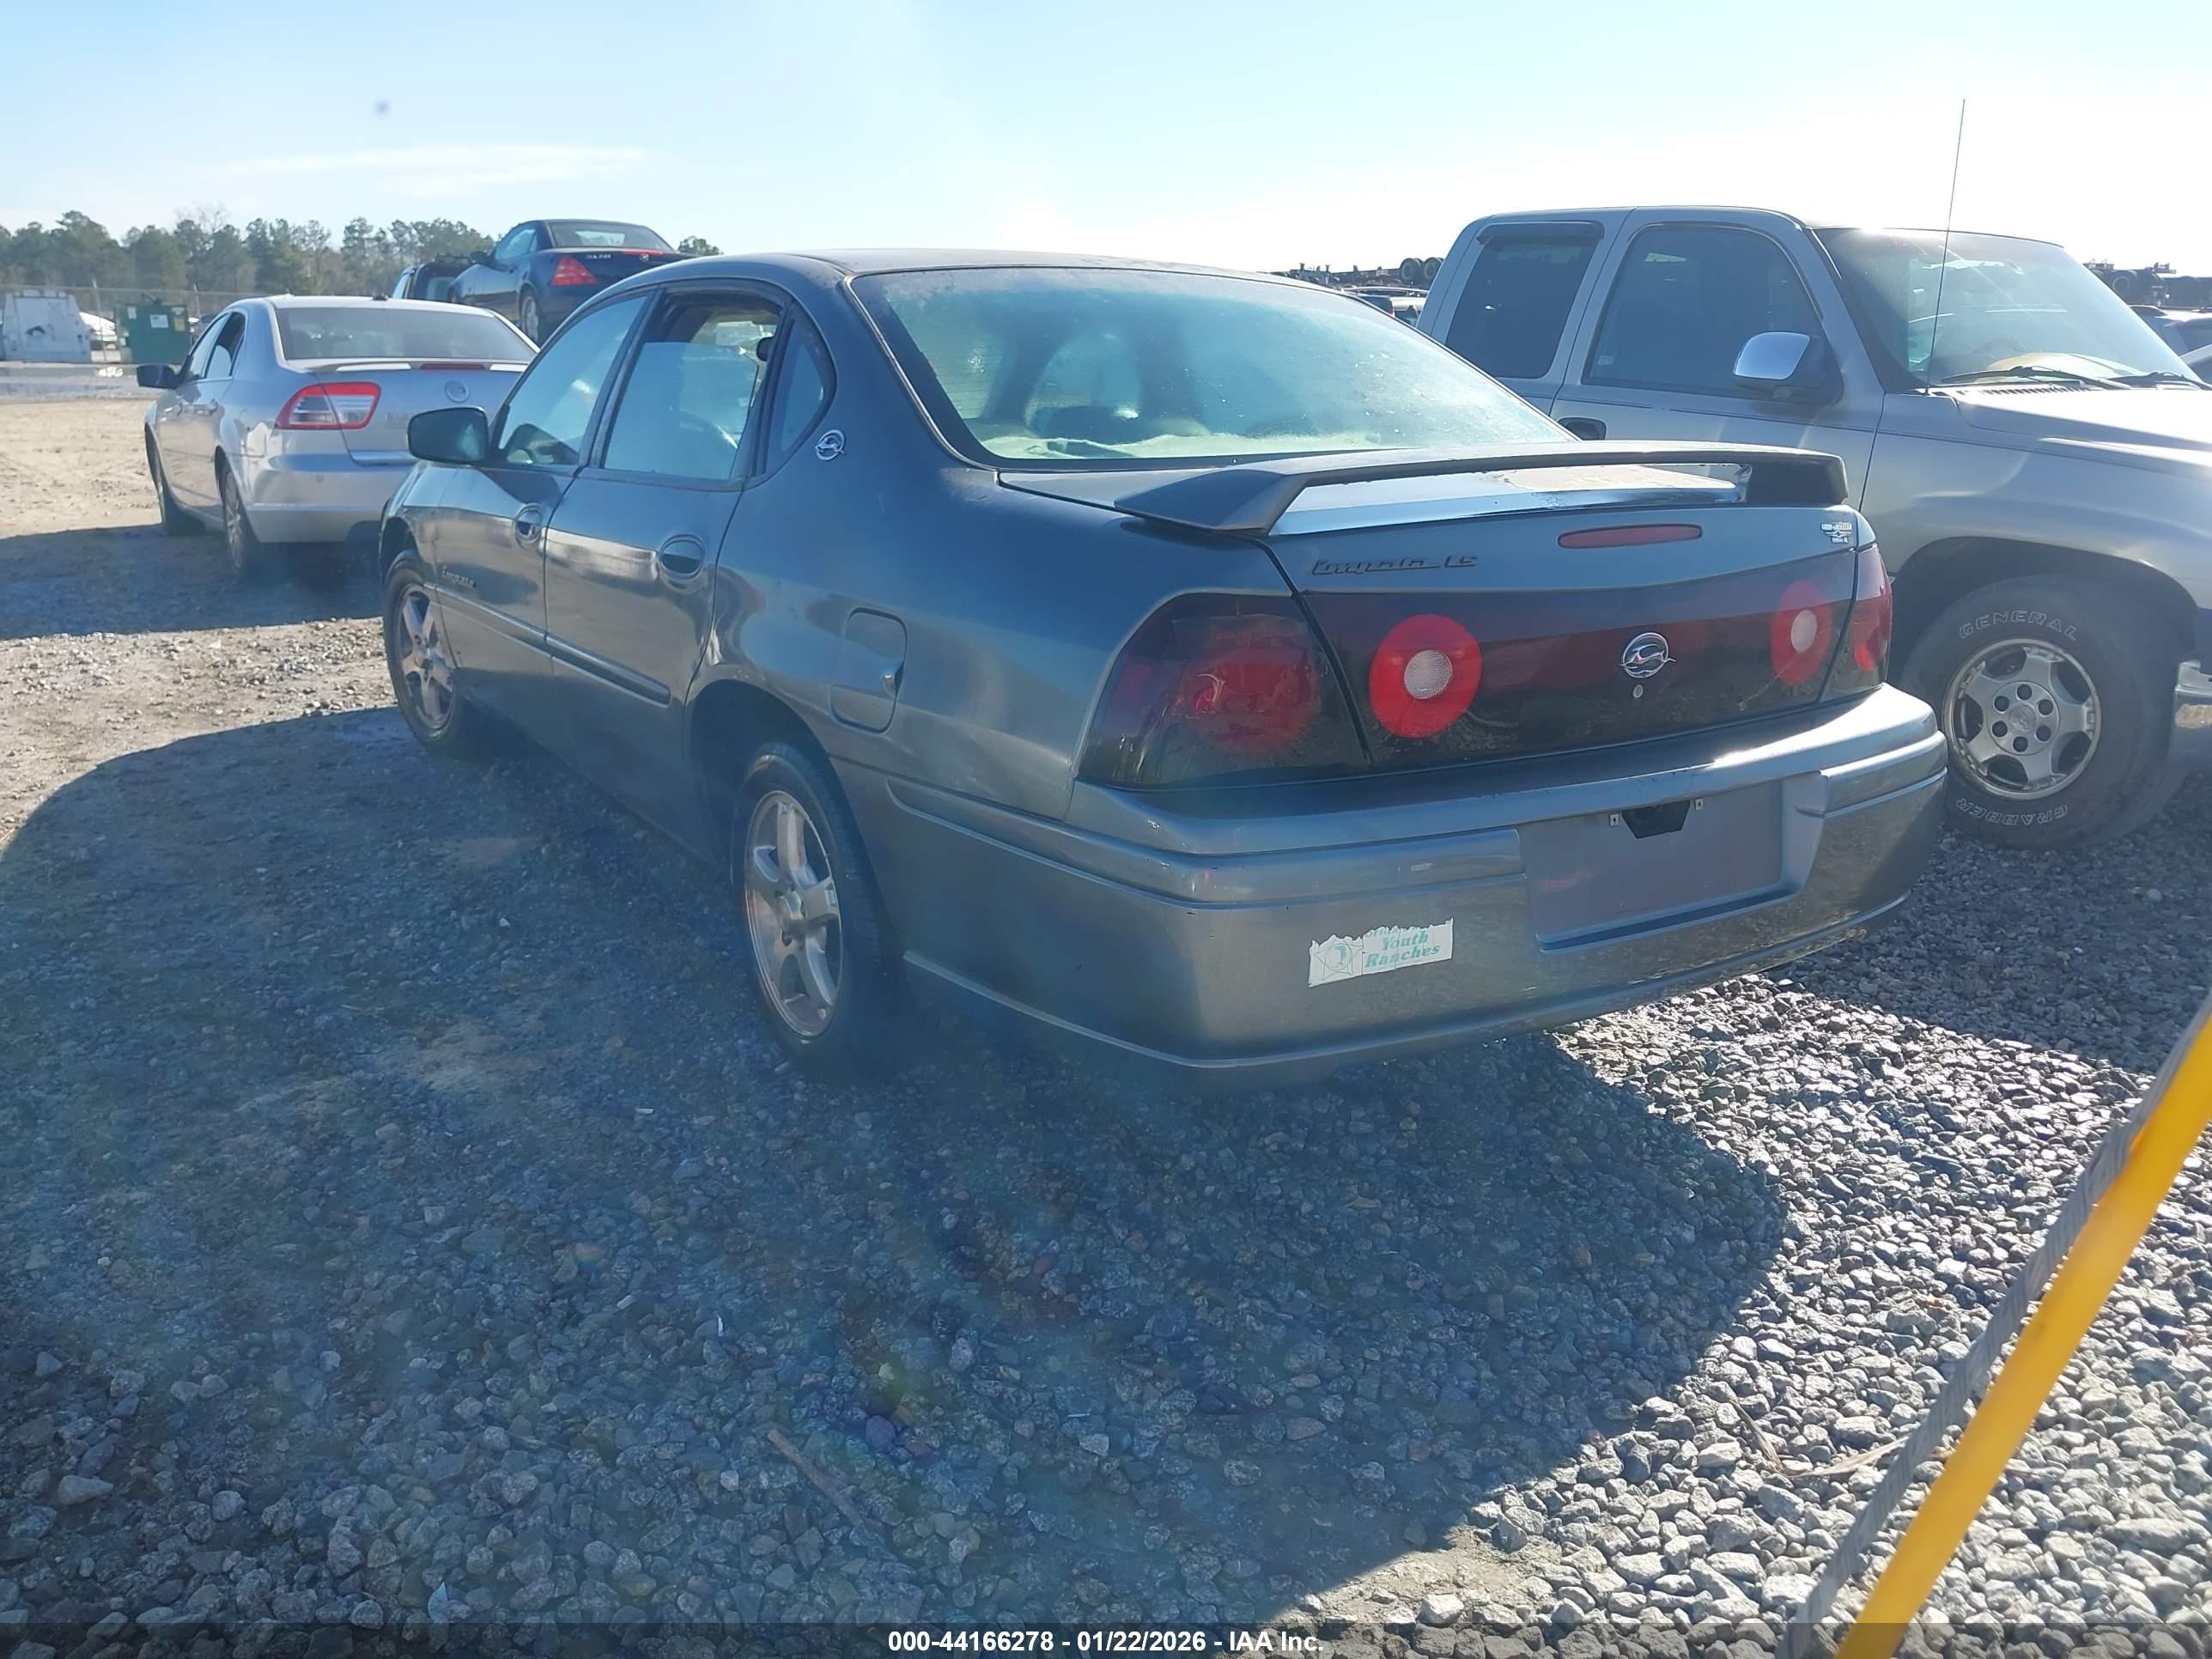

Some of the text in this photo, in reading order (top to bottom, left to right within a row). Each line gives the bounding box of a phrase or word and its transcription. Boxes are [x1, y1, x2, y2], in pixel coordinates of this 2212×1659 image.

[1958, 610, 2078, 641] GENERAL
[1955, 798, 2069, 825] GRABBER
[1381, 930, 1430, 951] Youth
[1364, 945, 1441, 968] Ranches
